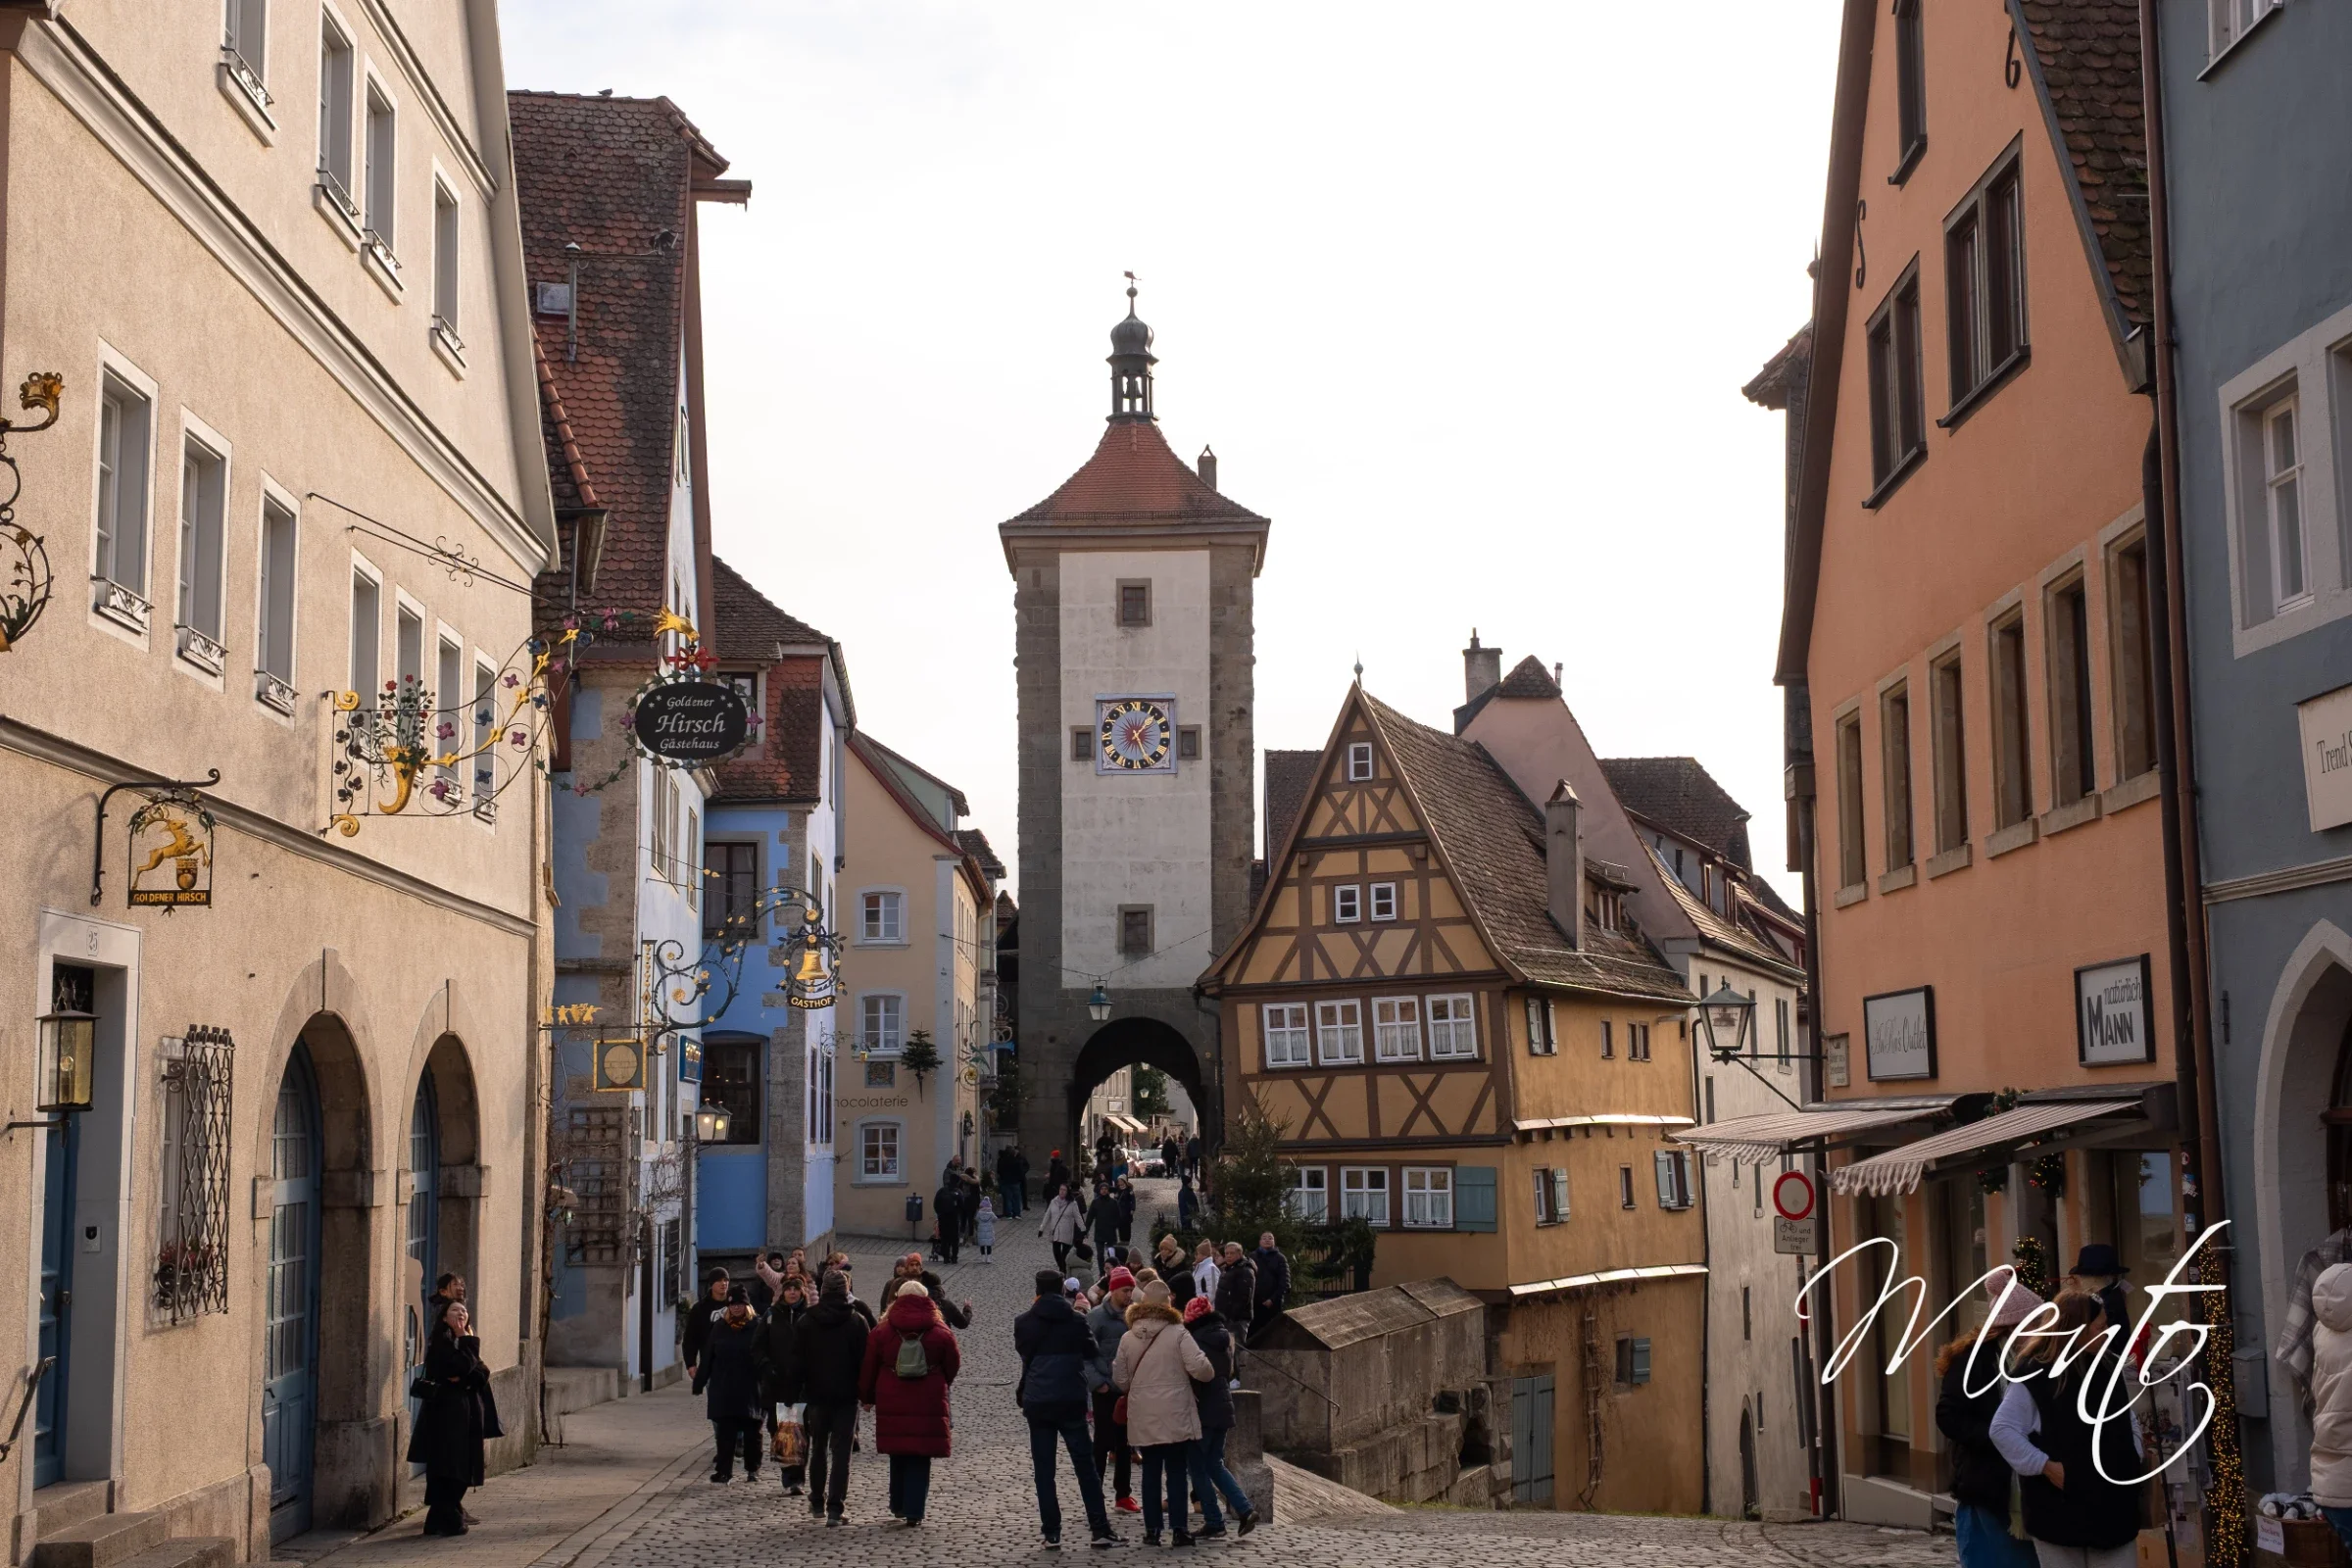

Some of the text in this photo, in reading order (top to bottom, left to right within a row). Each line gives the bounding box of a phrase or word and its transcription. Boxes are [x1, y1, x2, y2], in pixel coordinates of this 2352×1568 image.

[666, 696, 714, 710] Goldener
[655, 712, 726, 733] Hirsch
[660, 737, 720, 753] Gästehaus
[2317, 733, 2348, 773] Trend
[133, 893, 207, 902] GOLDENER HIRSCH
[2103, 977, 2142, 1005] natürlich
[791, 997, 833, 1008] GASTHOF
[1782, 1235, 1809, 1244] Anlieger
